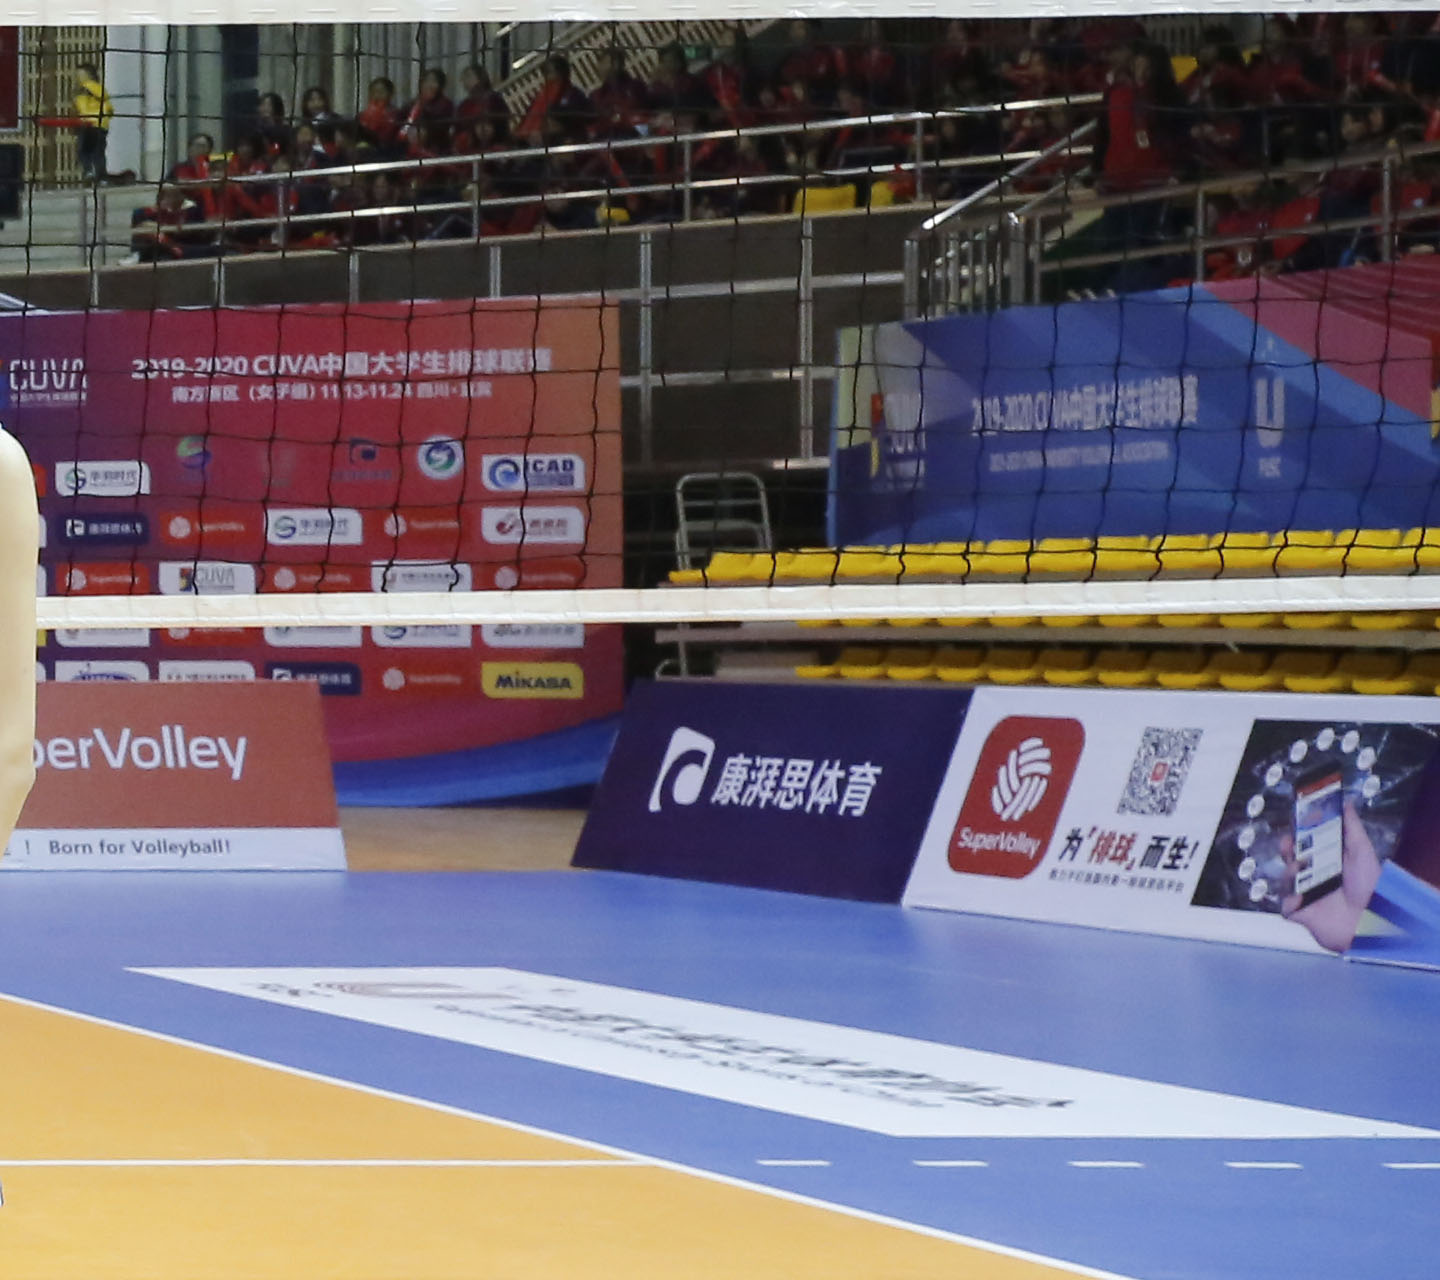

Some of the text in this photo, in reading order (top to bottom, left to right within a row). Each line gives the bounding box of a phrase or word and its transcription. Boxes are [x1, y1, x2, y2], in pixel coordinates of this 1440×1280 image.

[9, 358, 87, 392] CUVA
[711, 752, 883, 817] 康湃思体育
[49, 840, 92, 855] Born
[100, 839, 126, 855] for
[131, 838, 231, 859] Volleyball!
[957, 826, 1041, 860] SuperVolley
